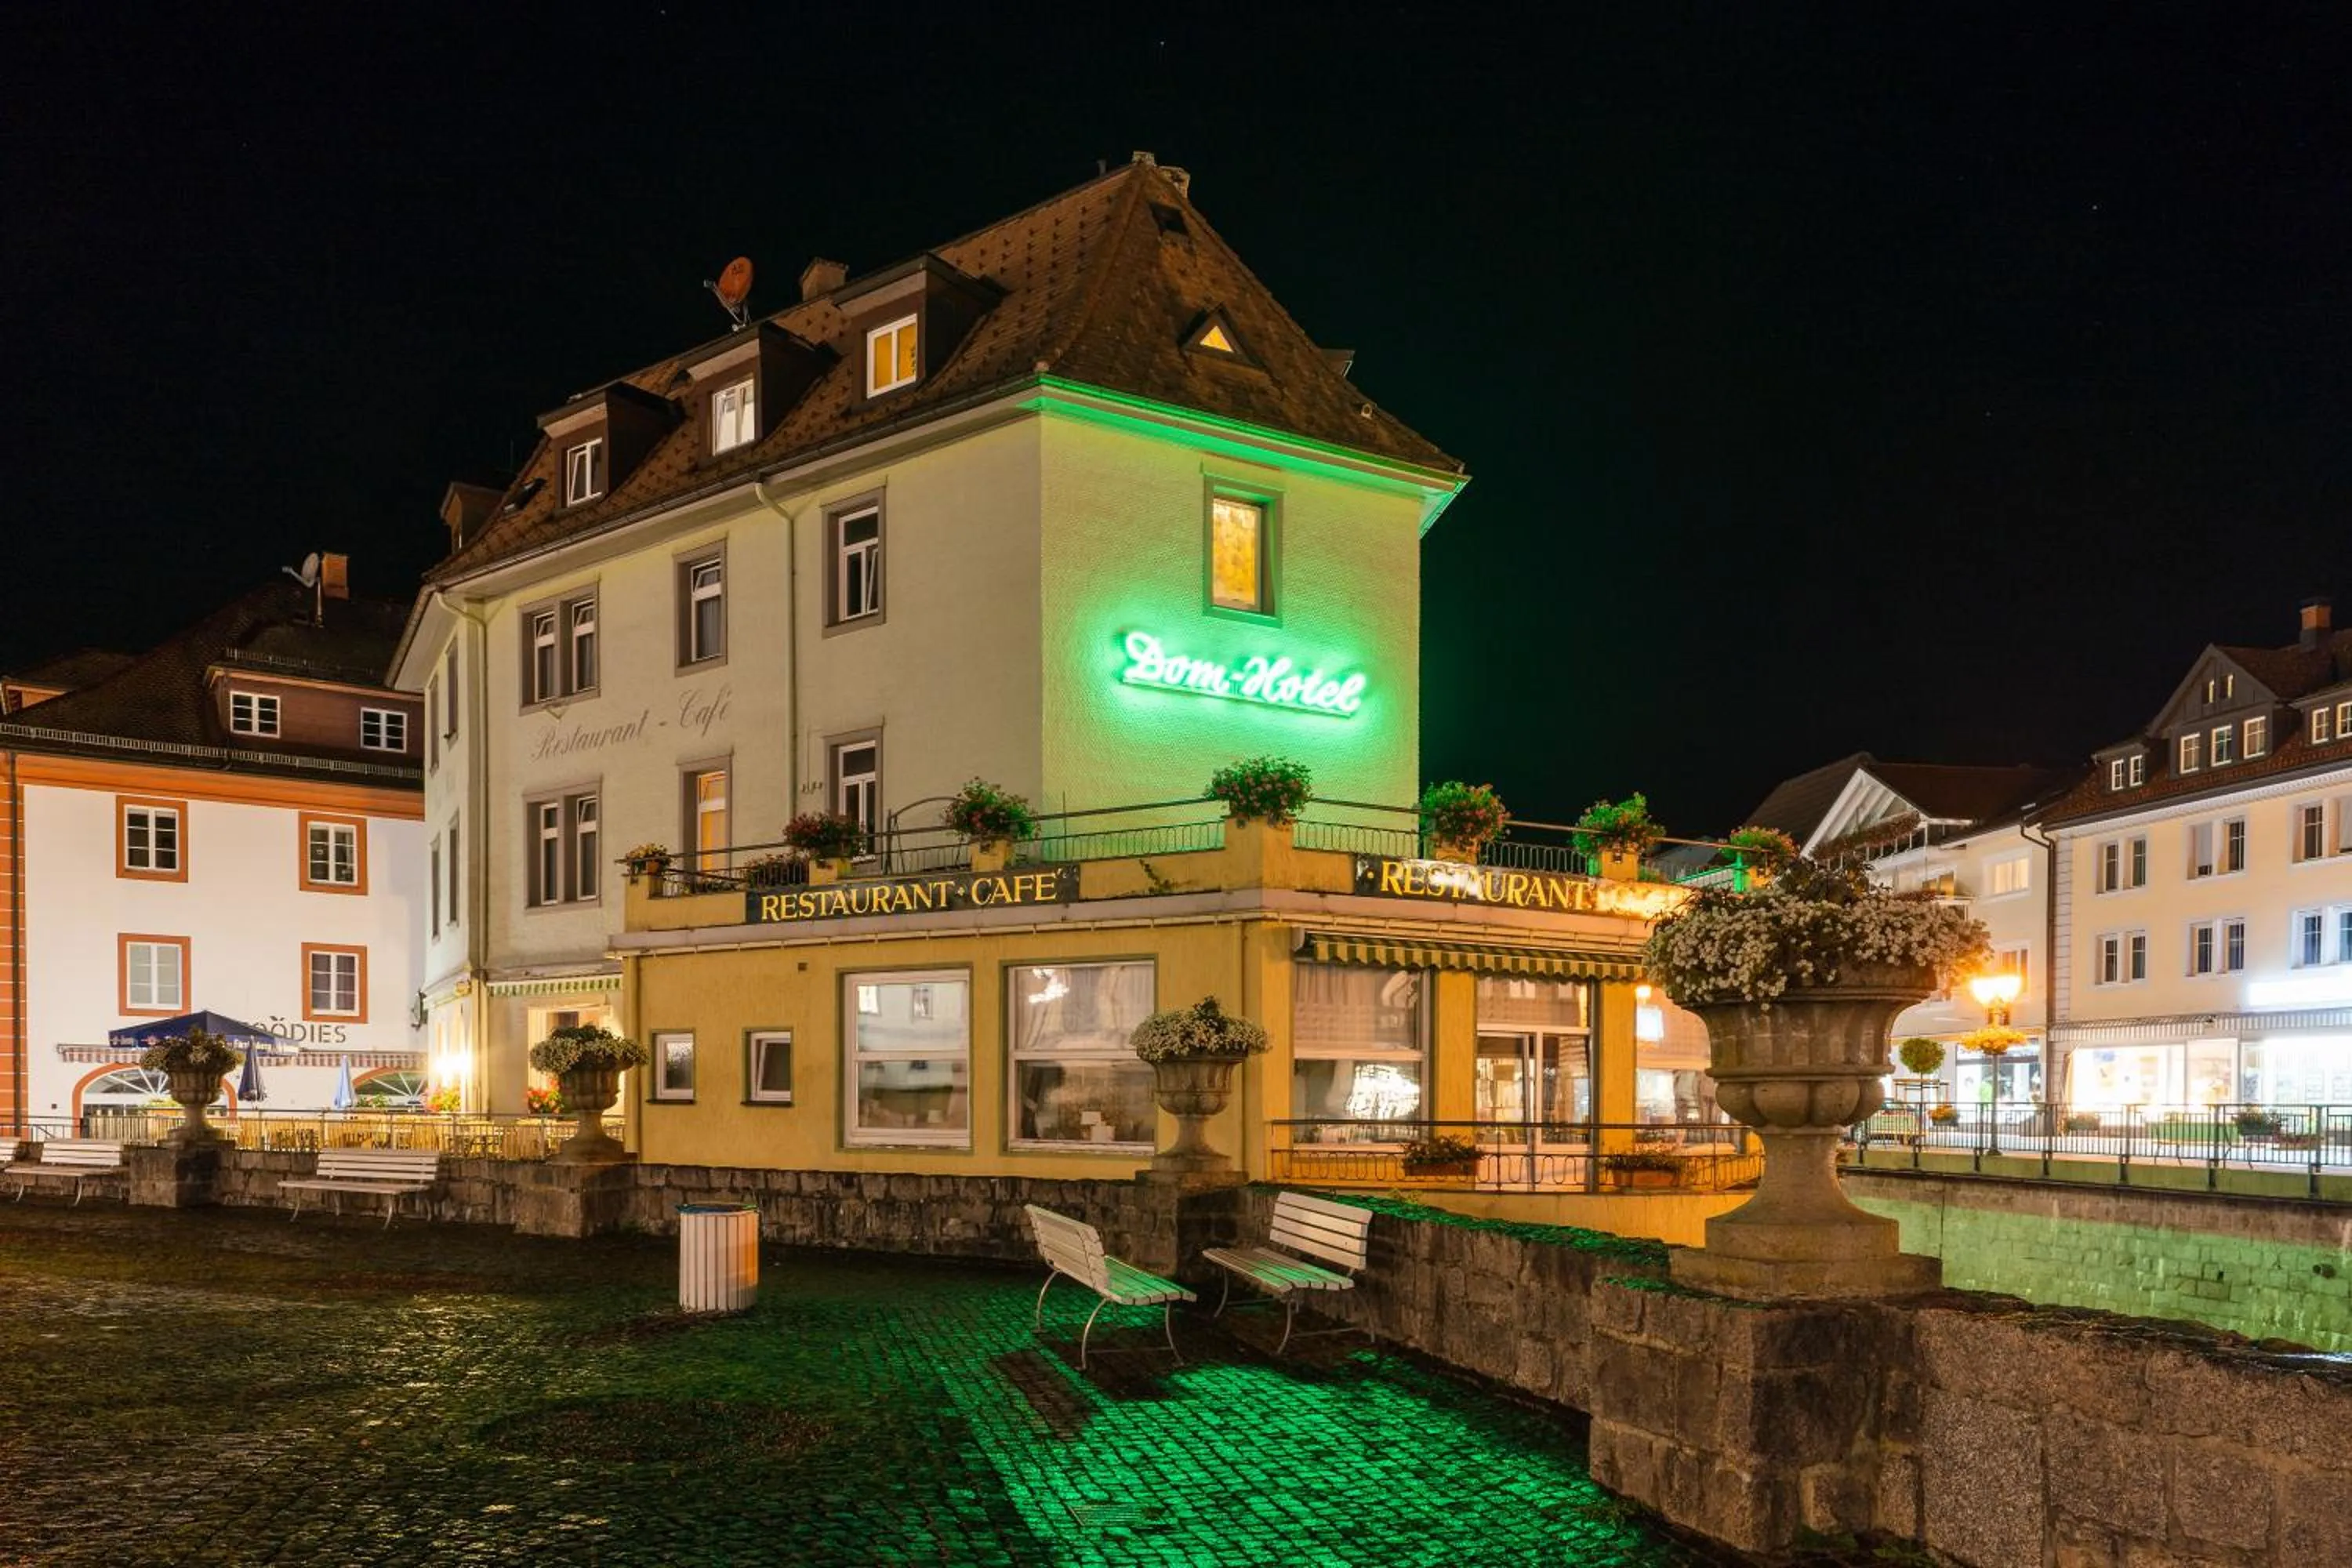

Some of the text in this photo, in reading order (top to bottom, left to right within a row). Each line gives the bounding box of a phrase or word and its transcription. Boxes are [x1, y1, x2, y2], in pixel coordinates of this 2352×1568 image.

[1124, 631, 1367, 712] Dom-Hotel
[531, 710, 650, 764] Restaurant
[760, 880, 954, 921] RESTAURANT
[1381, 861, 1592, 910] RESTAURANT
